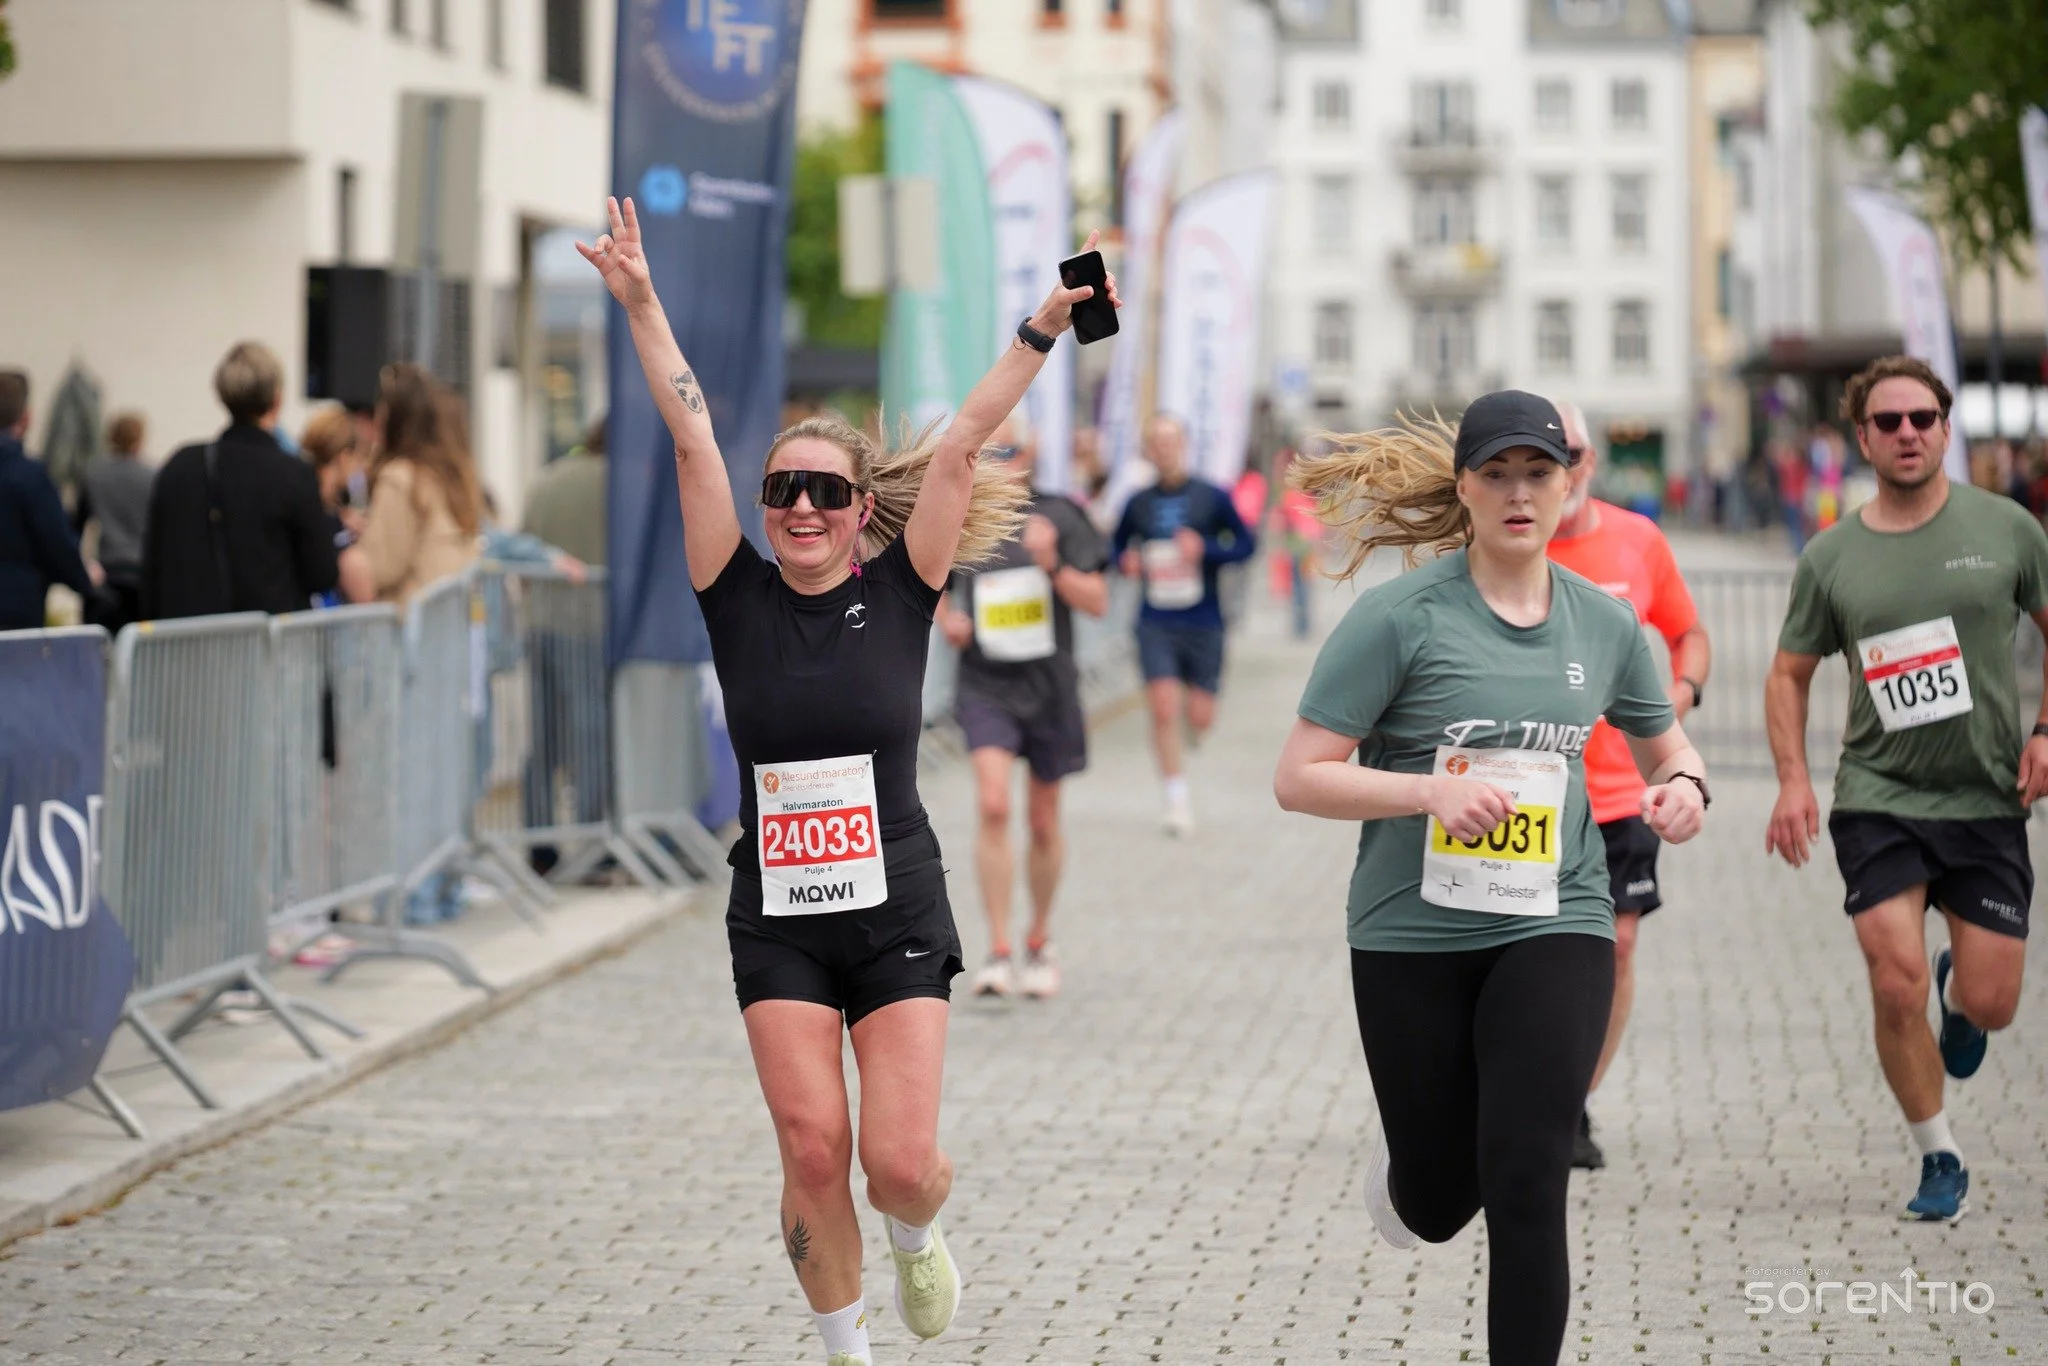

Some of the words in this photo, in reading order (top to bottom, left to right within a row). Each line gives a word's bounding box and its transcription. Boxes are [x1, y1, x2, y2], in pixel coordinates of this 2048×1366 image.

[1881, 664, 1959, 711] 1035
[822, 766, 864, 779] maraton
[782, 799, 844, 811] Halvmaraton
[765, 813, 872, 860] 24033
[1445, 812, 1548, 855] 031
[805, 866, 825, 876] Pulje
[1480, 860, 1504, 872] Pulje
[1506, 863, 1512, 871] 3
[1488, 882, 1541, 899] Polestar
